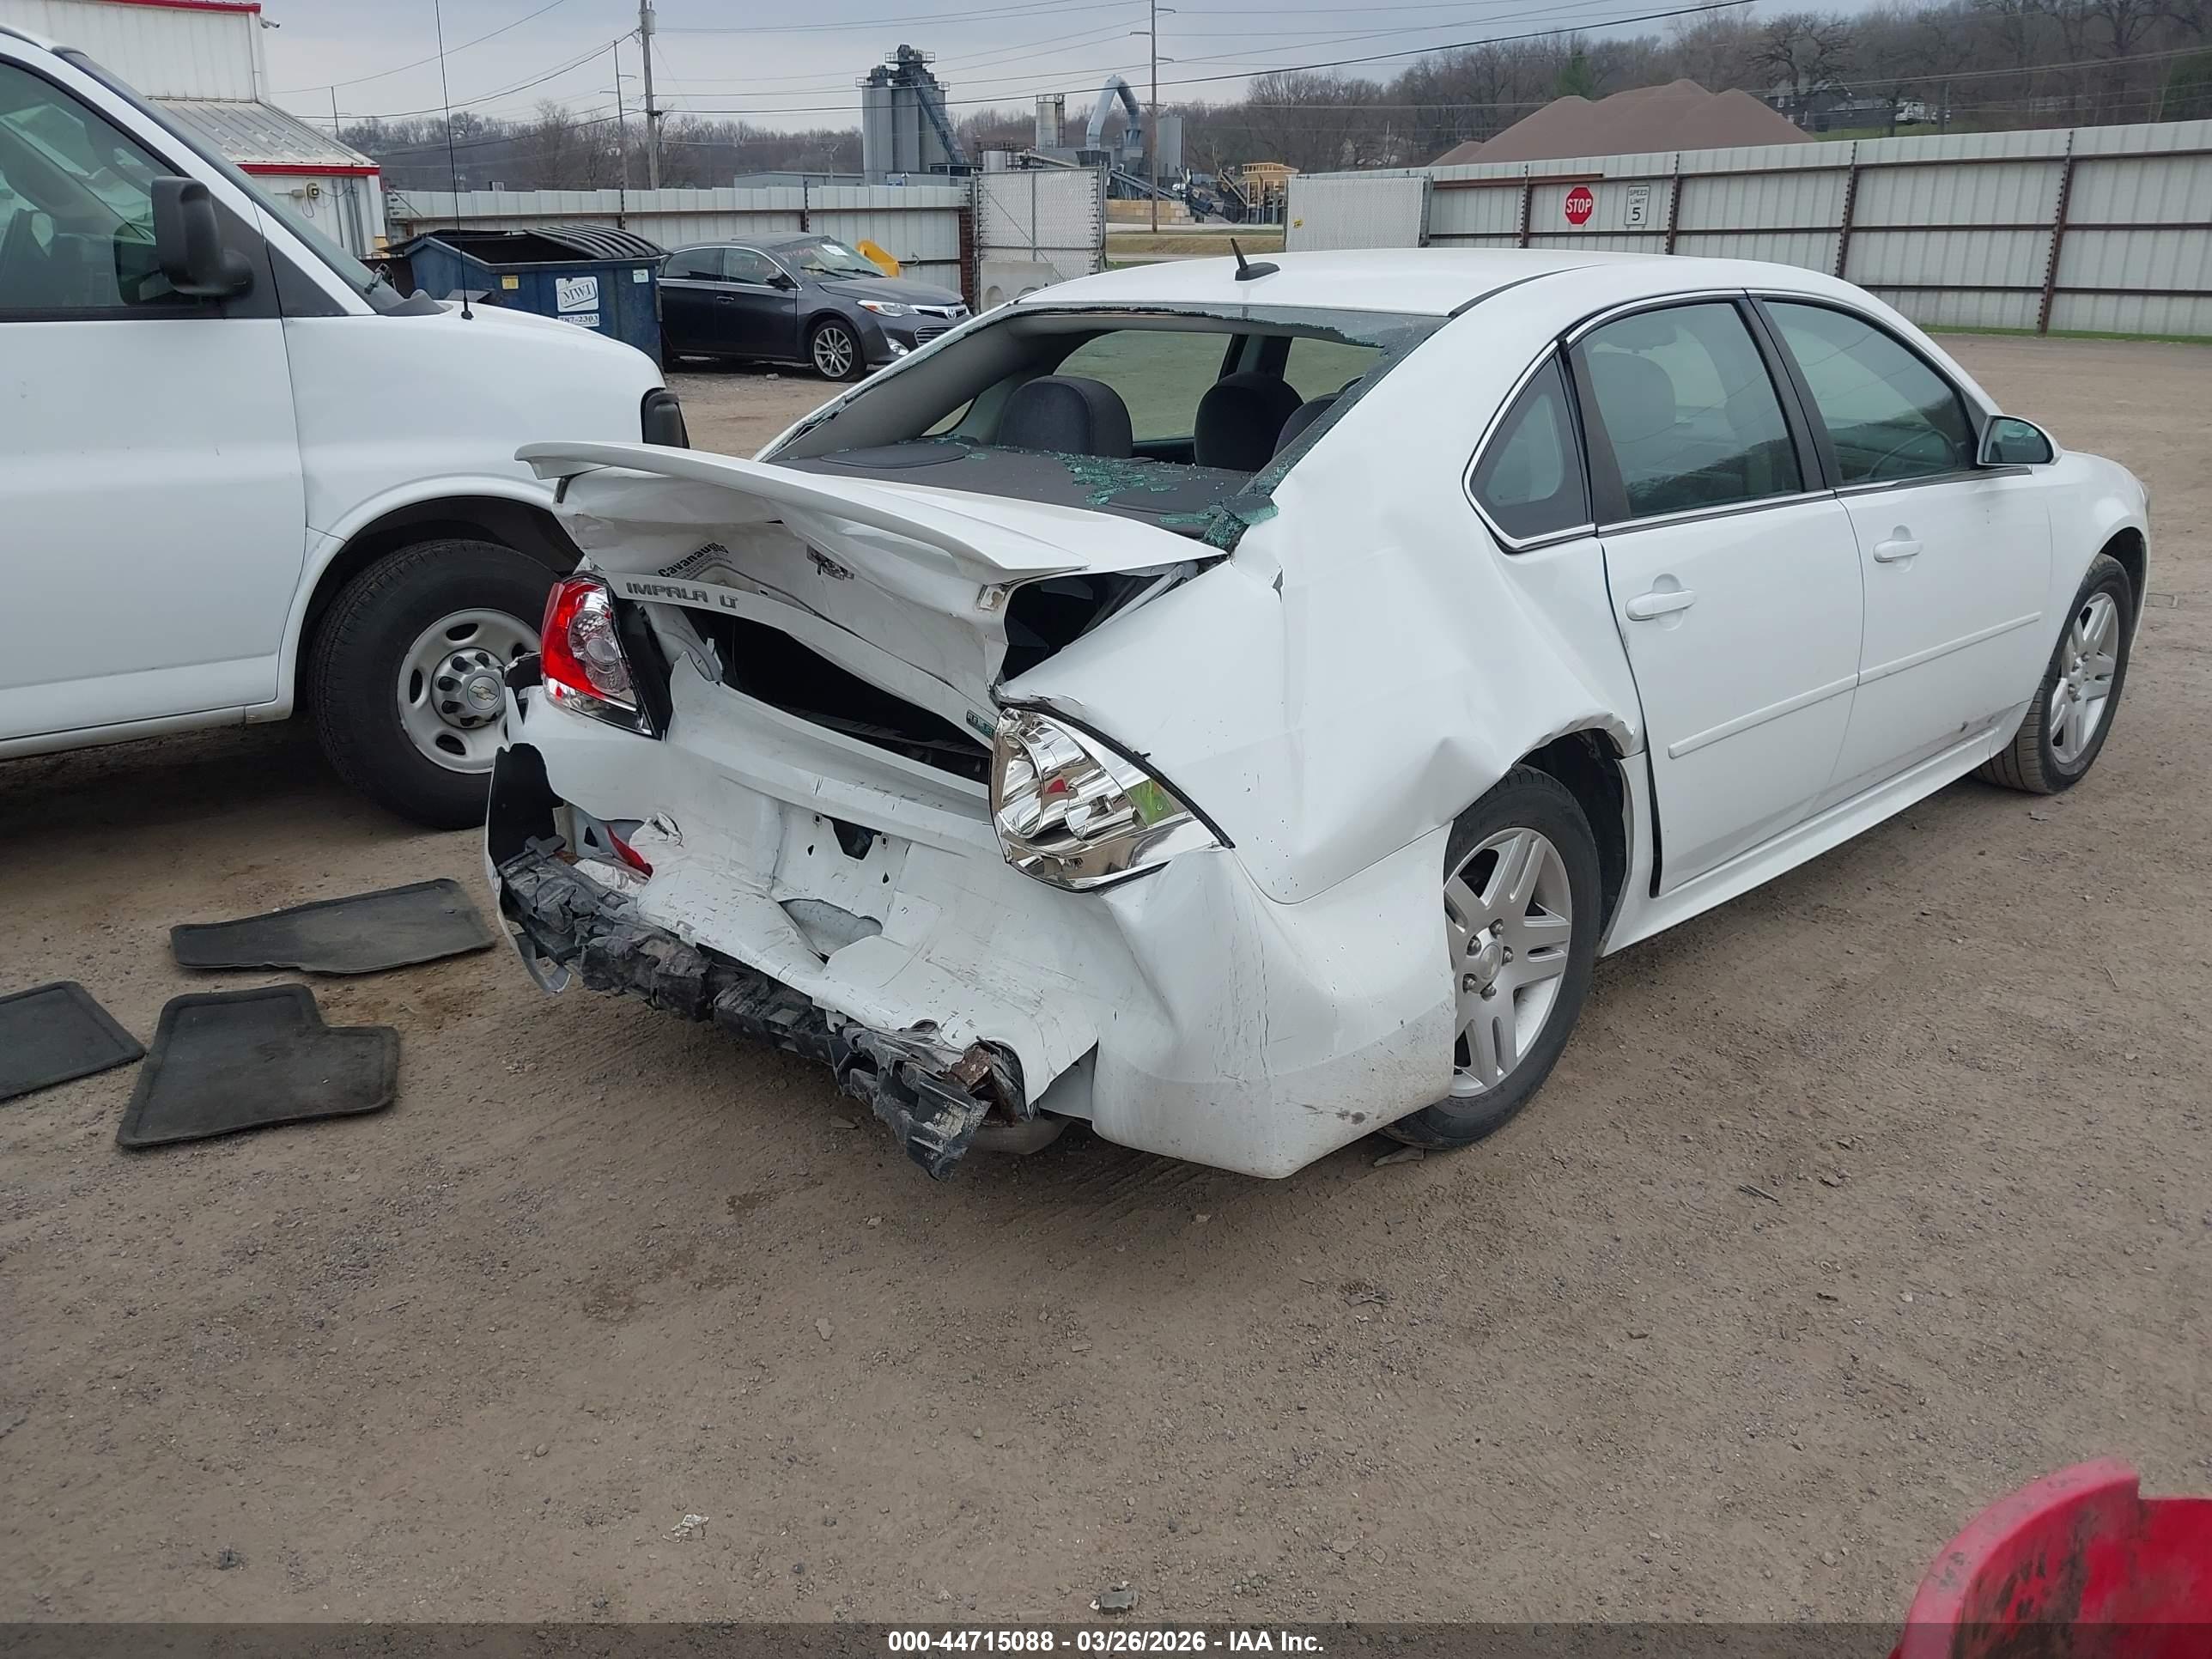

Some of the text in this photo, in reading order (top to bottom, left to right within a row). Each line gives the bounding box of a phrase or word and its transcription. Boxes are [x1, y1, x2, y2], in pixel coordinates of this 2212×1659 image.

[1566, 198, 1592, 214] STOP
[1632, 207, 1641, 221] 5
[626, 582, 738, 609] IMPALA LT
